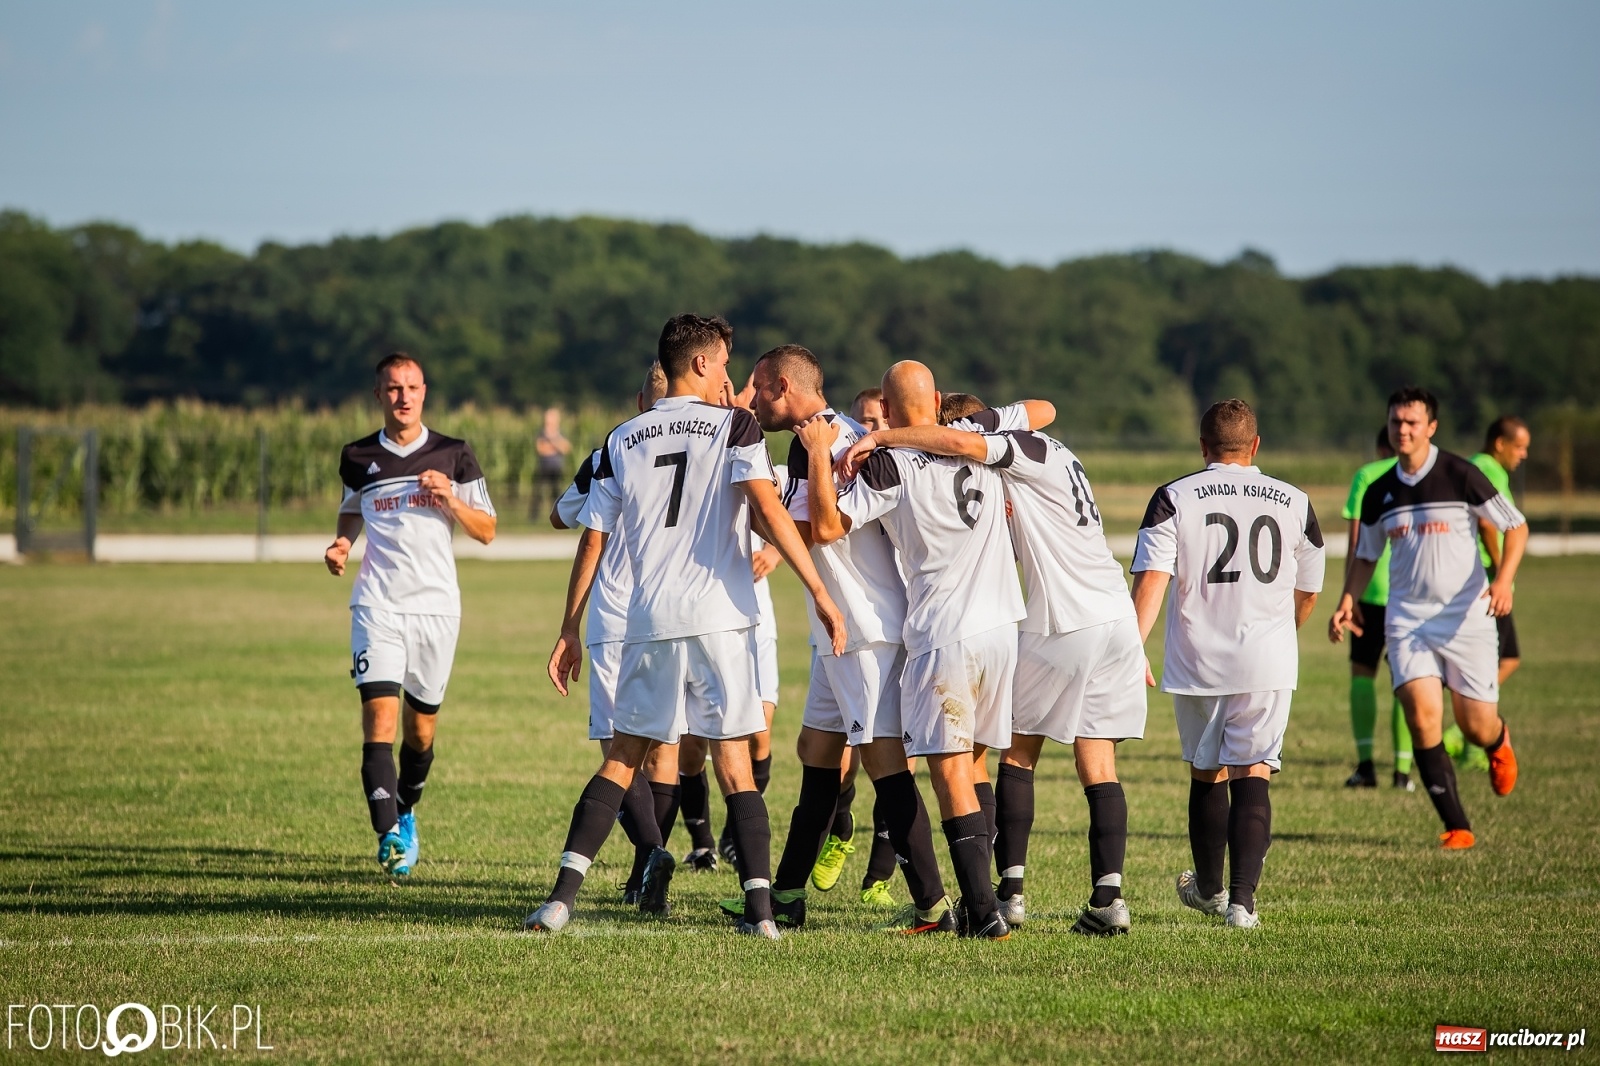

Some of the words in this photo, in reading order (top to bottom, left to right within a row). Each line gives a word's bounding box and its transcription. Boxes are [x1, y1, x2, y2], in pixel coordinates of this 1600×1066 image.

[624, 424, 663, 450] ZAWADA
[374, 497, 400, 512] DUET
[653, 451, 688, 529] 7
[953, 465, 985, 531] 6
[1194, 484, 1238, 500] ZAWADA
[1205, 512, 1283, 585] 20
